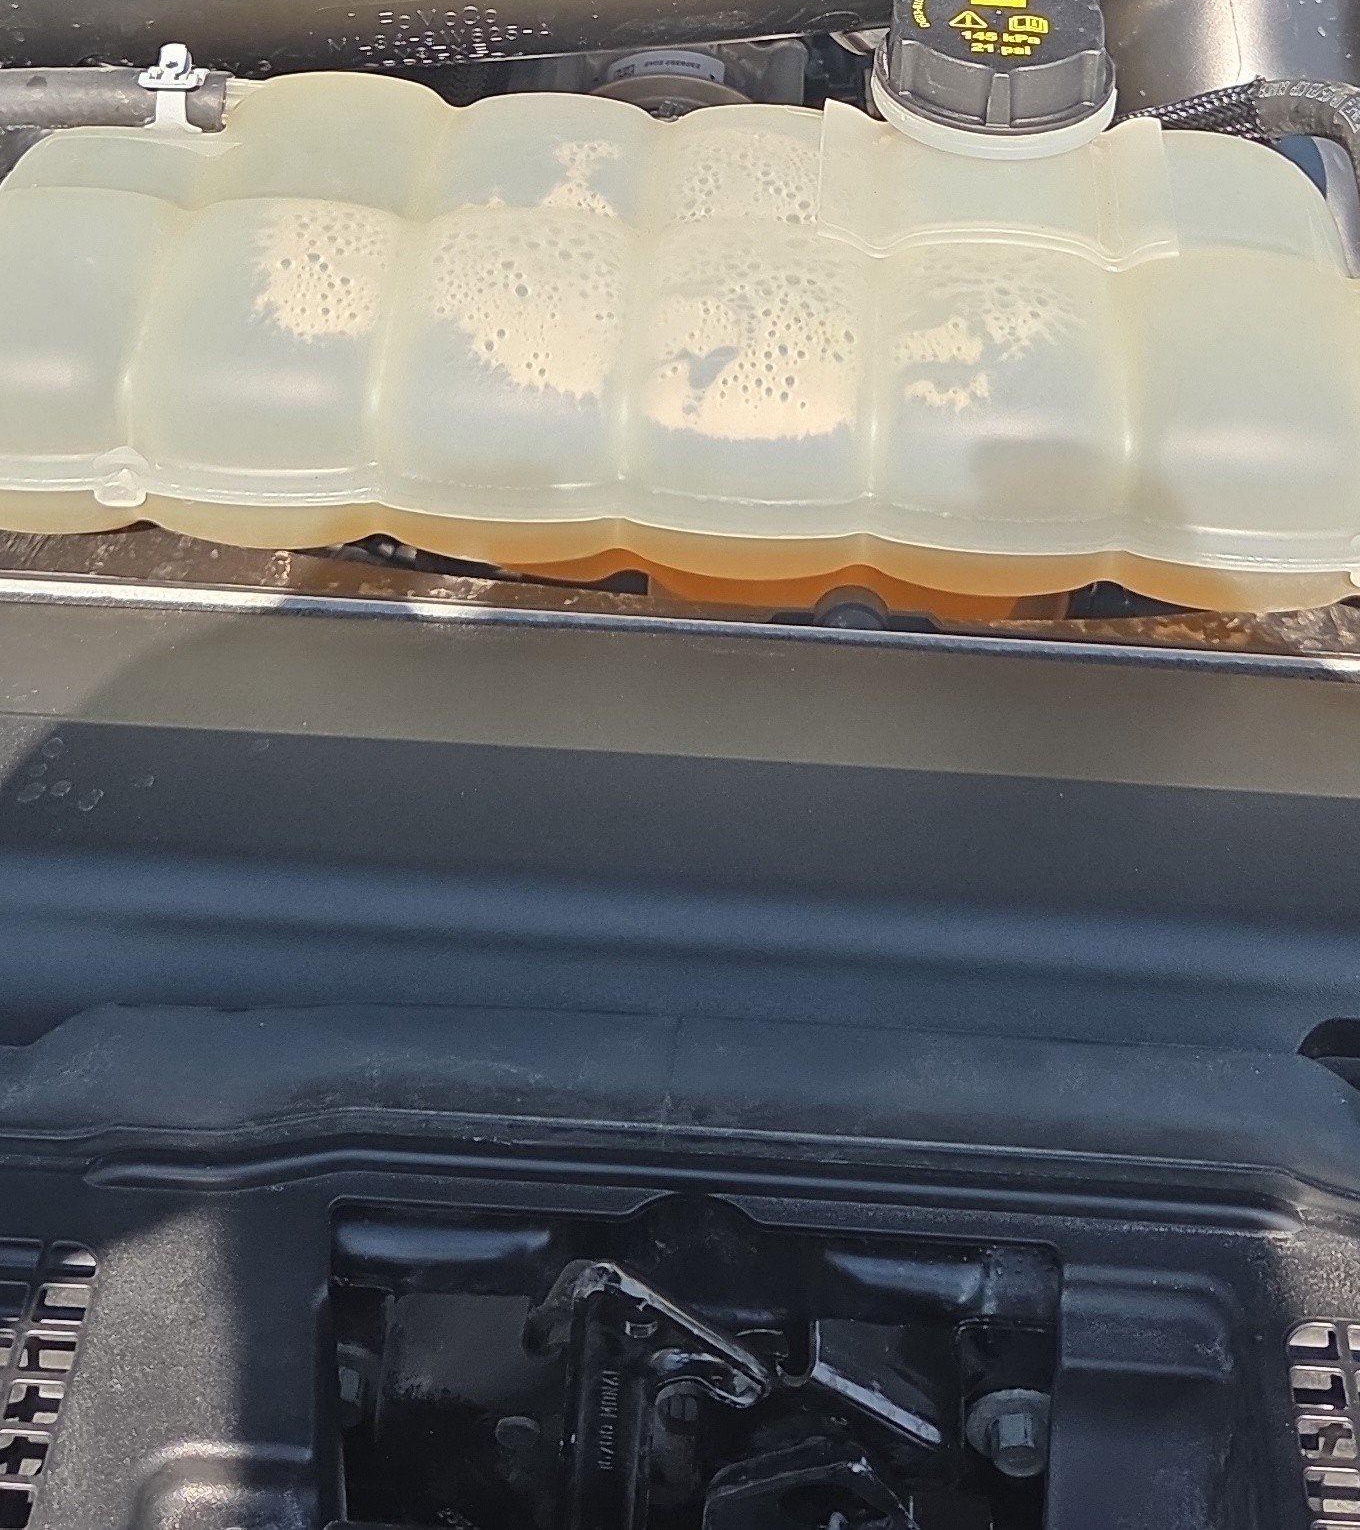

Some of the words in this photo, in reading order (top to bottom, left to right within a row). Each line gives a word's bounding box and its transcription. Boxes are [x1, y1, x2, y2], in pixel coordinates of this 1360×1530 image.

[961, 30, 998, 42] 145
[1002, 32, 1041, 45] kPa
[970, 42, 994, 53] 21
[1000, 45, 1032, 56] psi
